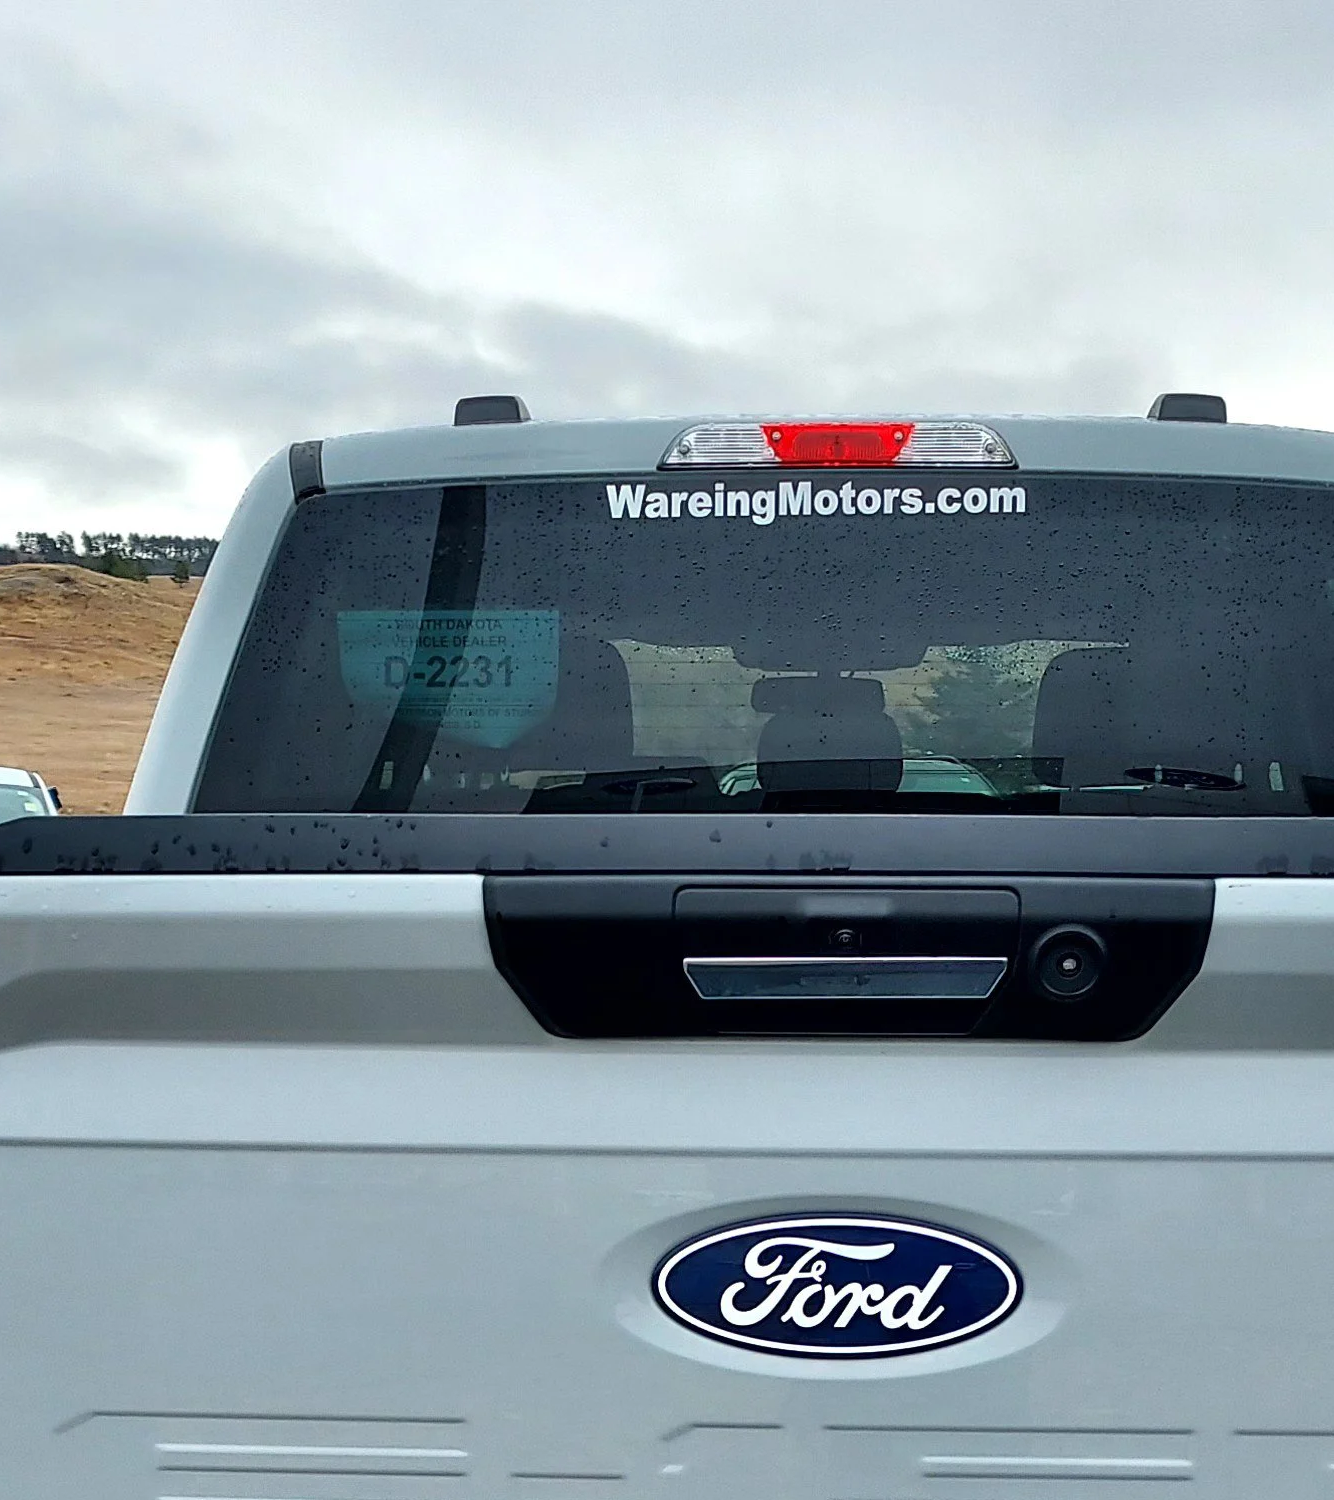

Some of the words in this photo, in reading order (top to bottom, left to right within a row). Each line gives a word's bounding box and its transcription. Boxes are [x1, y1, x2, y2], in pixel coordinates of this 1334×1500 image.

[606, 481, 1026, 525] WareingMotors.com
[396, 619, 442, 630] SOUTH
[447, 619, 503, 630] DAKOTA
[393, 636, 450, 648] VEHICLE
[453, 636, 507, 648] DEALER
[383, 655, 513, 688] D-2231
[720, 1236, 953, 1330] Ford
